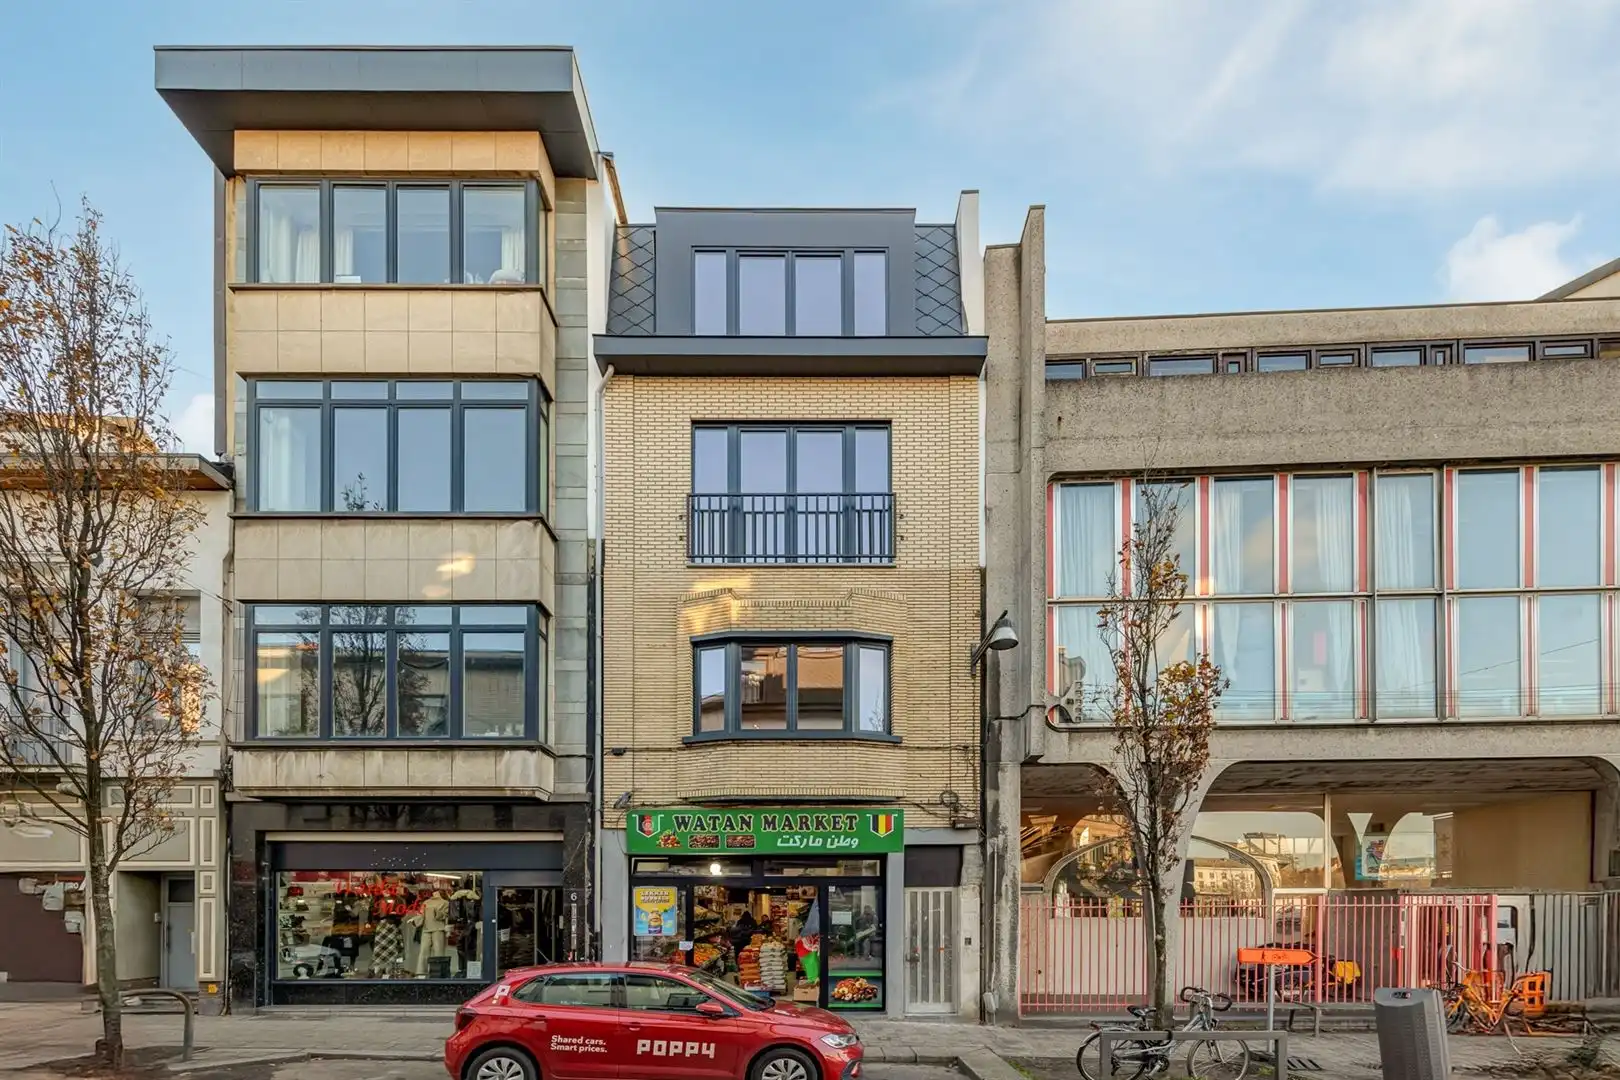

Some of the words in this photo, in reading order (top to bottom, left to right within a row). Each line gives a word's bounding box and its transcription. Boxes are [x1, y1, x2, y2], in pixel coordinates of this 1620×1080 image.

[672, 813, 754, 832] WATAN
[761, 813, 859, 832] MARKET
[570, 892, 578, 901] 6
[551, 1035, 584, 1045] Shared
[585, 1038, 607, 1046] cars.
[550, 1042, 578, 1051] Smart
[578, 1043, 608, 1053] prices.
[636, 1039, 716, 1059] POPPY
